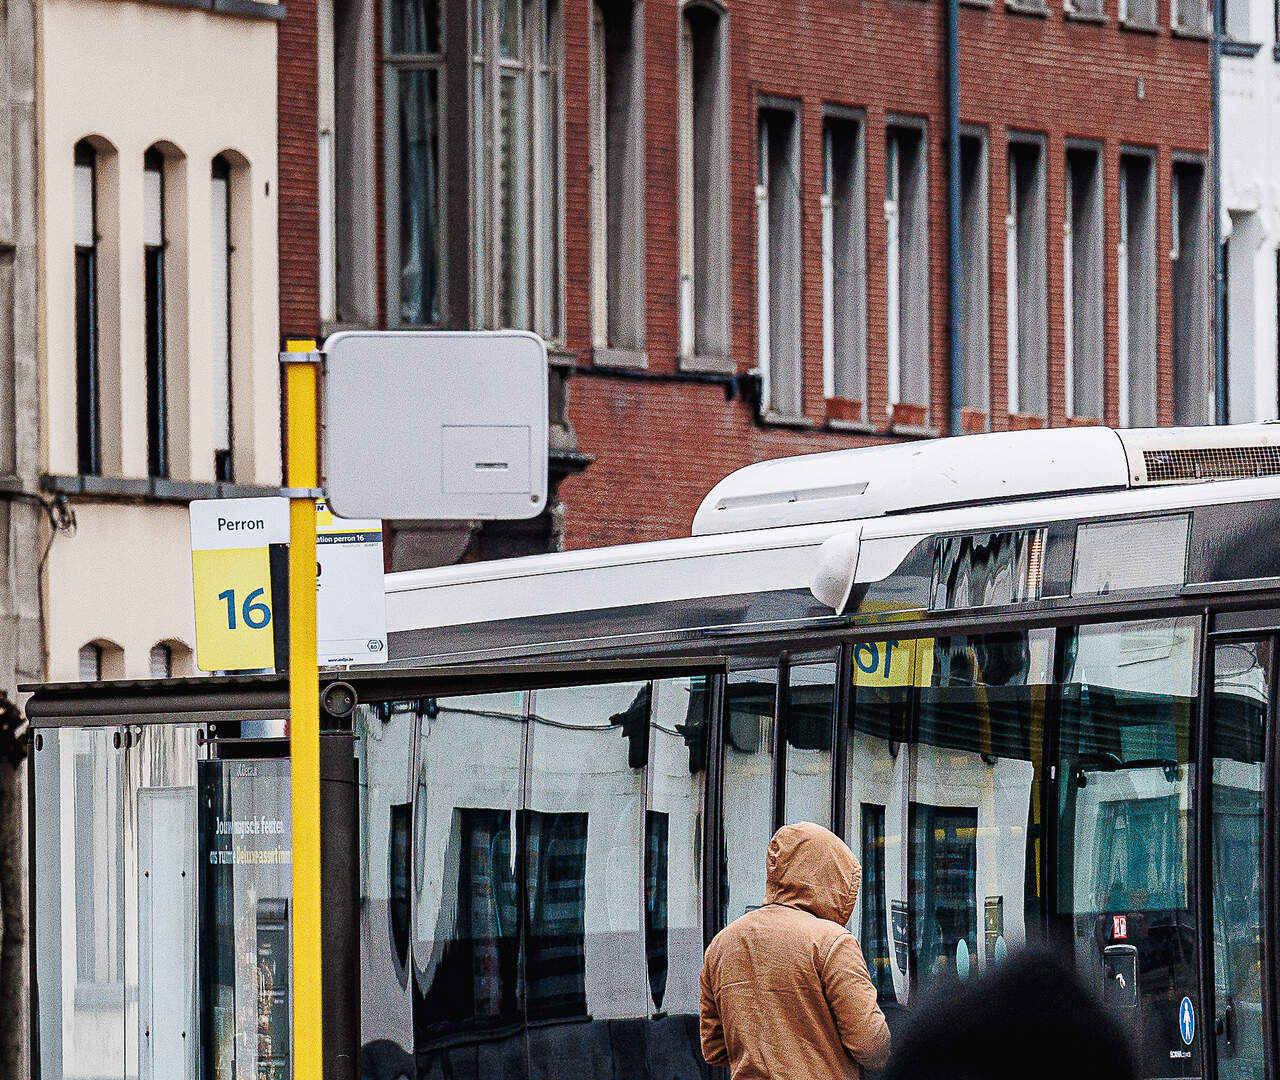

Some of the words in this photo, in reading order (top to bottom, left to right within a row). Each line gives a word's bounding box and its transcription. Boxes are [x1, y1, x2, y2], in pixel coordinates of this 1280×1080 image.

[217, 517, 265, 532] Perron
[334, 536, 355, 545] perron
[218, 587, 272, 630] 16
